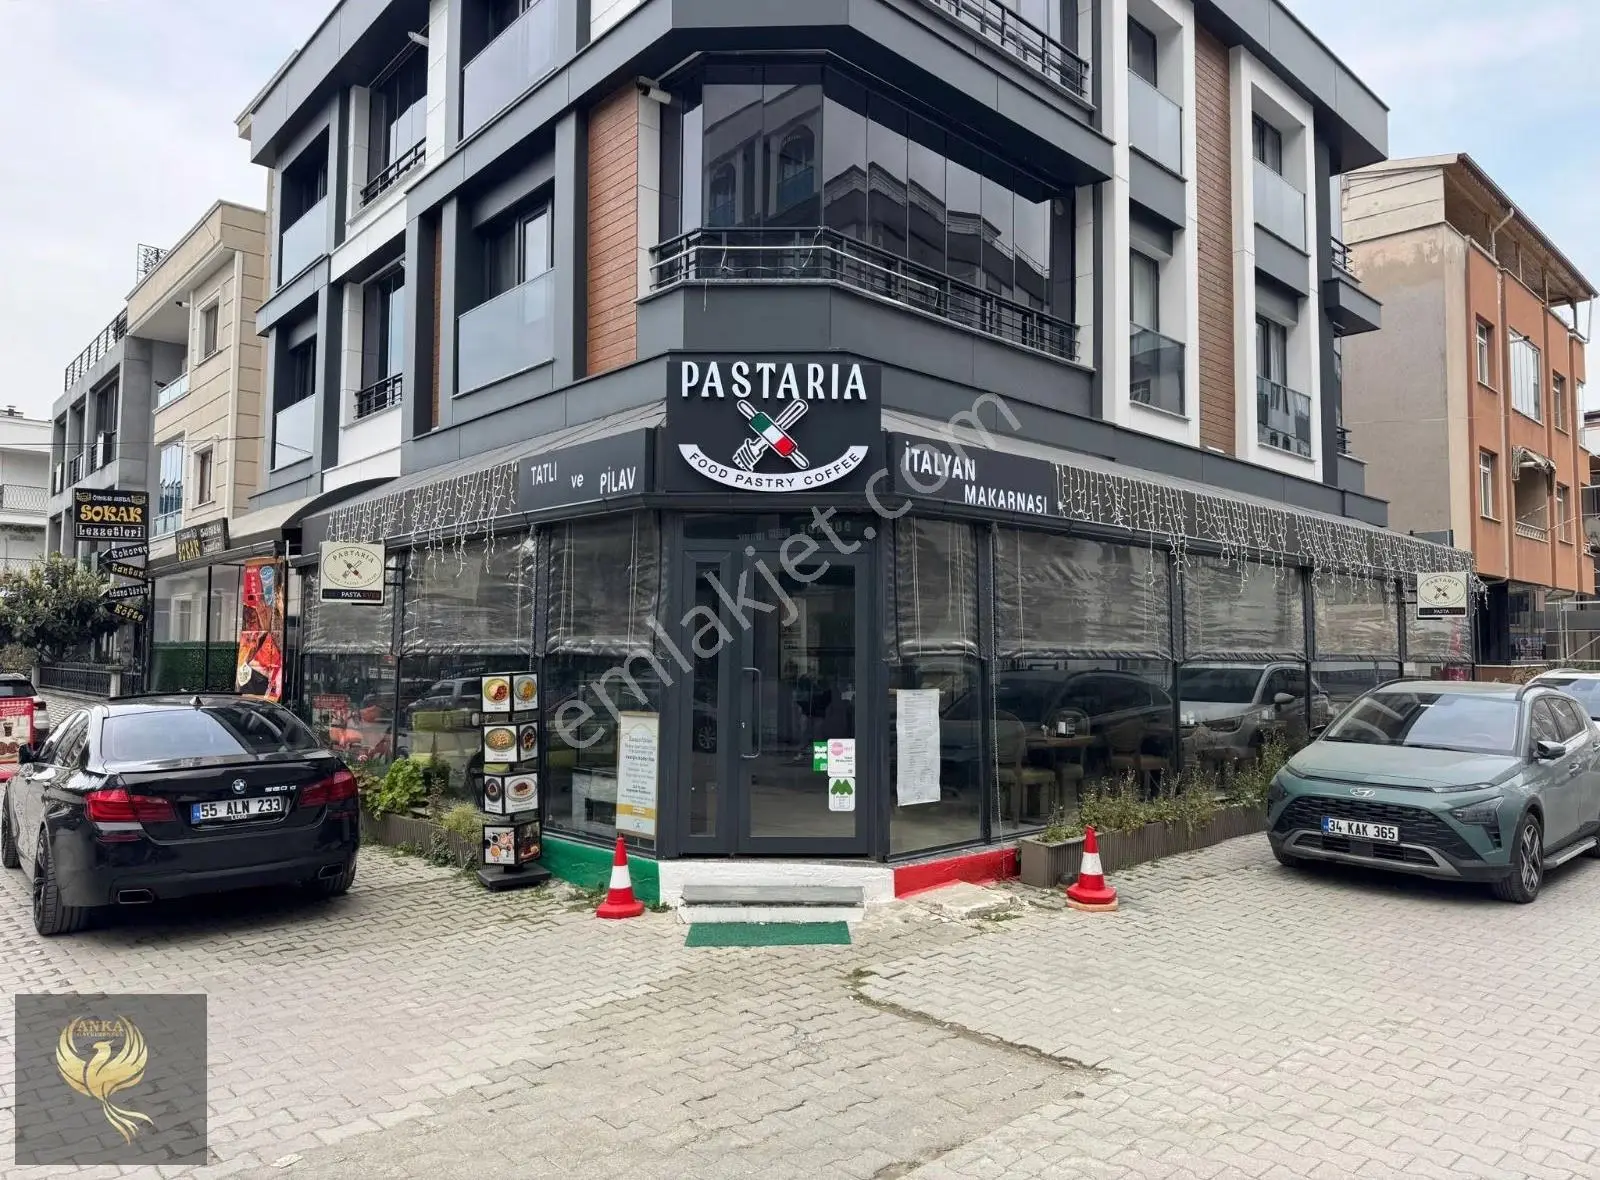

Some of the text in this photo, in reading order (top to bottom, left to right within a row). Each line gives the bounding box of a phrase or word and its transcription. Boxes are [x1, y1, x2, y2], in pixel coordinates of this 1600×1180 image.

[681, 361, 867, 400] PASTARIA
[689, 452, 861, 488] FOOD PASTRY COFFEE
[905, 440, 976, 481] İTALYAN
[530, 461, 636, 495] TATLI ve PİLAV
[80, 504, 143, 523] SOKAK
[964, 484, 1048, 514] MAKARNASI
[201, 803, 218, 817] 55
[226, 801, 250, 815] ALN
[257, 798, 282, 813] 233
[1329, 820, 1342, 832] 34
[1348, 822, 1368, 836] KAK
[1373, 825, 1395, 839] 365
